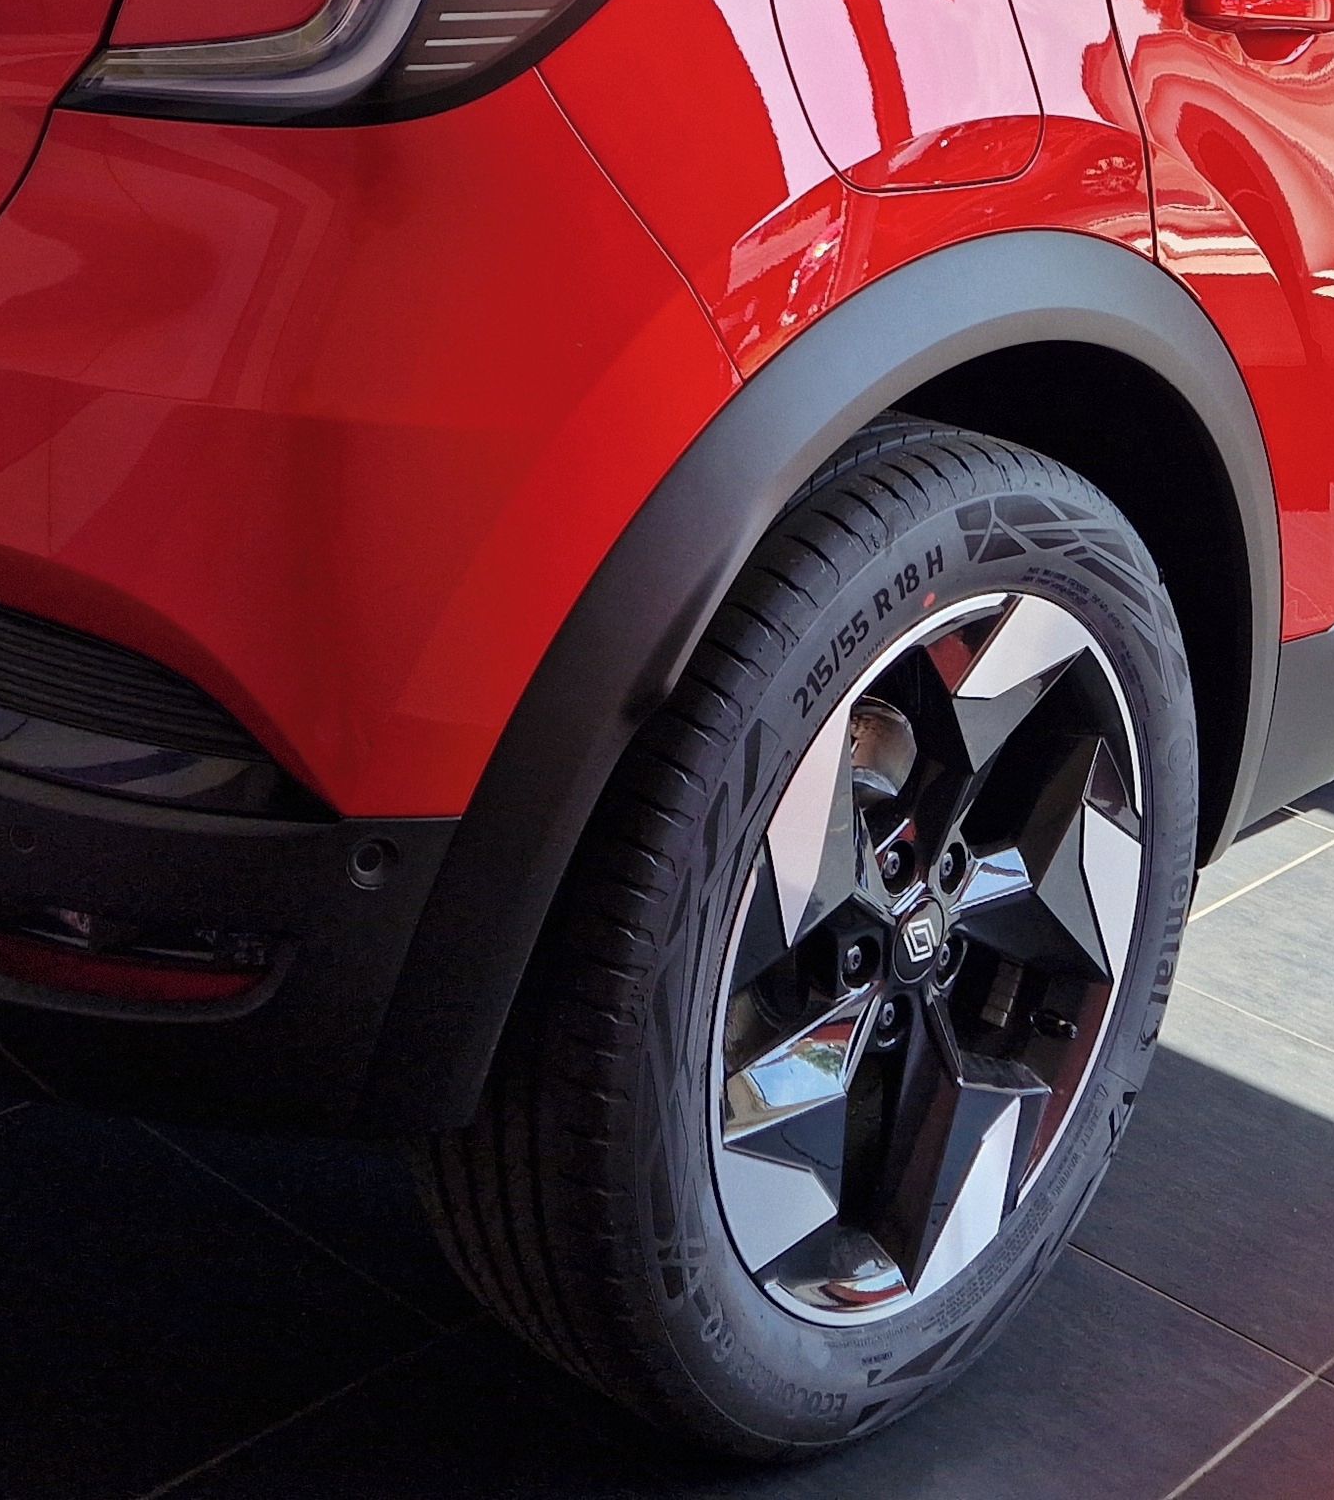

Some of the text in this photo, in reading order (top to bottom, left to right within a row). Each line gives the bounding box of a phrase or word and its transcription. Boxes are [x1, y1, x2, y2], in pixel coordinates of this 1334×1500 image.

[793, 610, 870, 718] 215/55
[872, 588, 893, 620] R
[894, 563, 920, 600] 18
[925, 545, 944, 578] H
